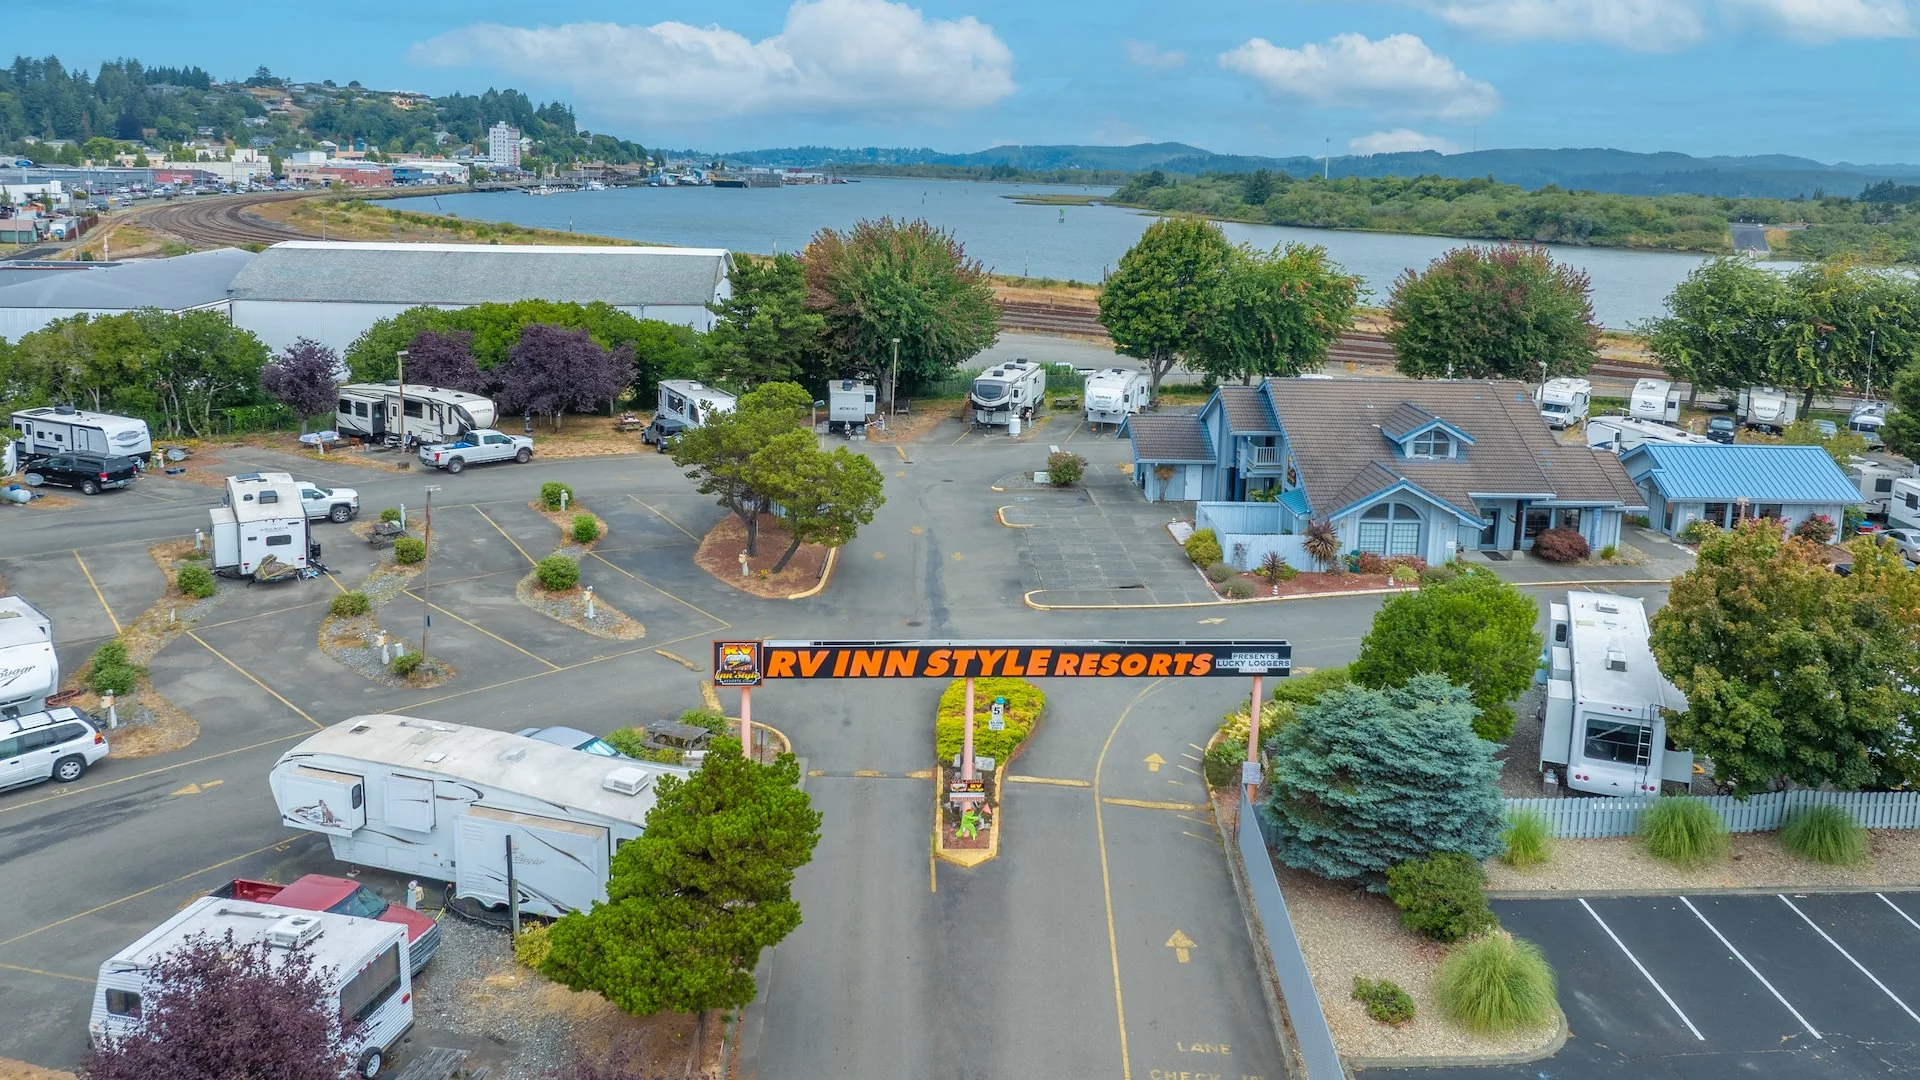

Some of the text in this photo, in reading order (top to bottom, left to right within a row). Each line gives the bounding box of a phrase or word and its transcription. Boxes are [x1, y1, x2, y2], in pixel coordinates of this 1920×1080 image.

[723, 645, 754, 655] RV
[766, 649, 1213, 678] RV INN STYLE RESORTS
[993, 707, 1000, 715] 5
[1176, 1041, 1233, 1055] LANE
